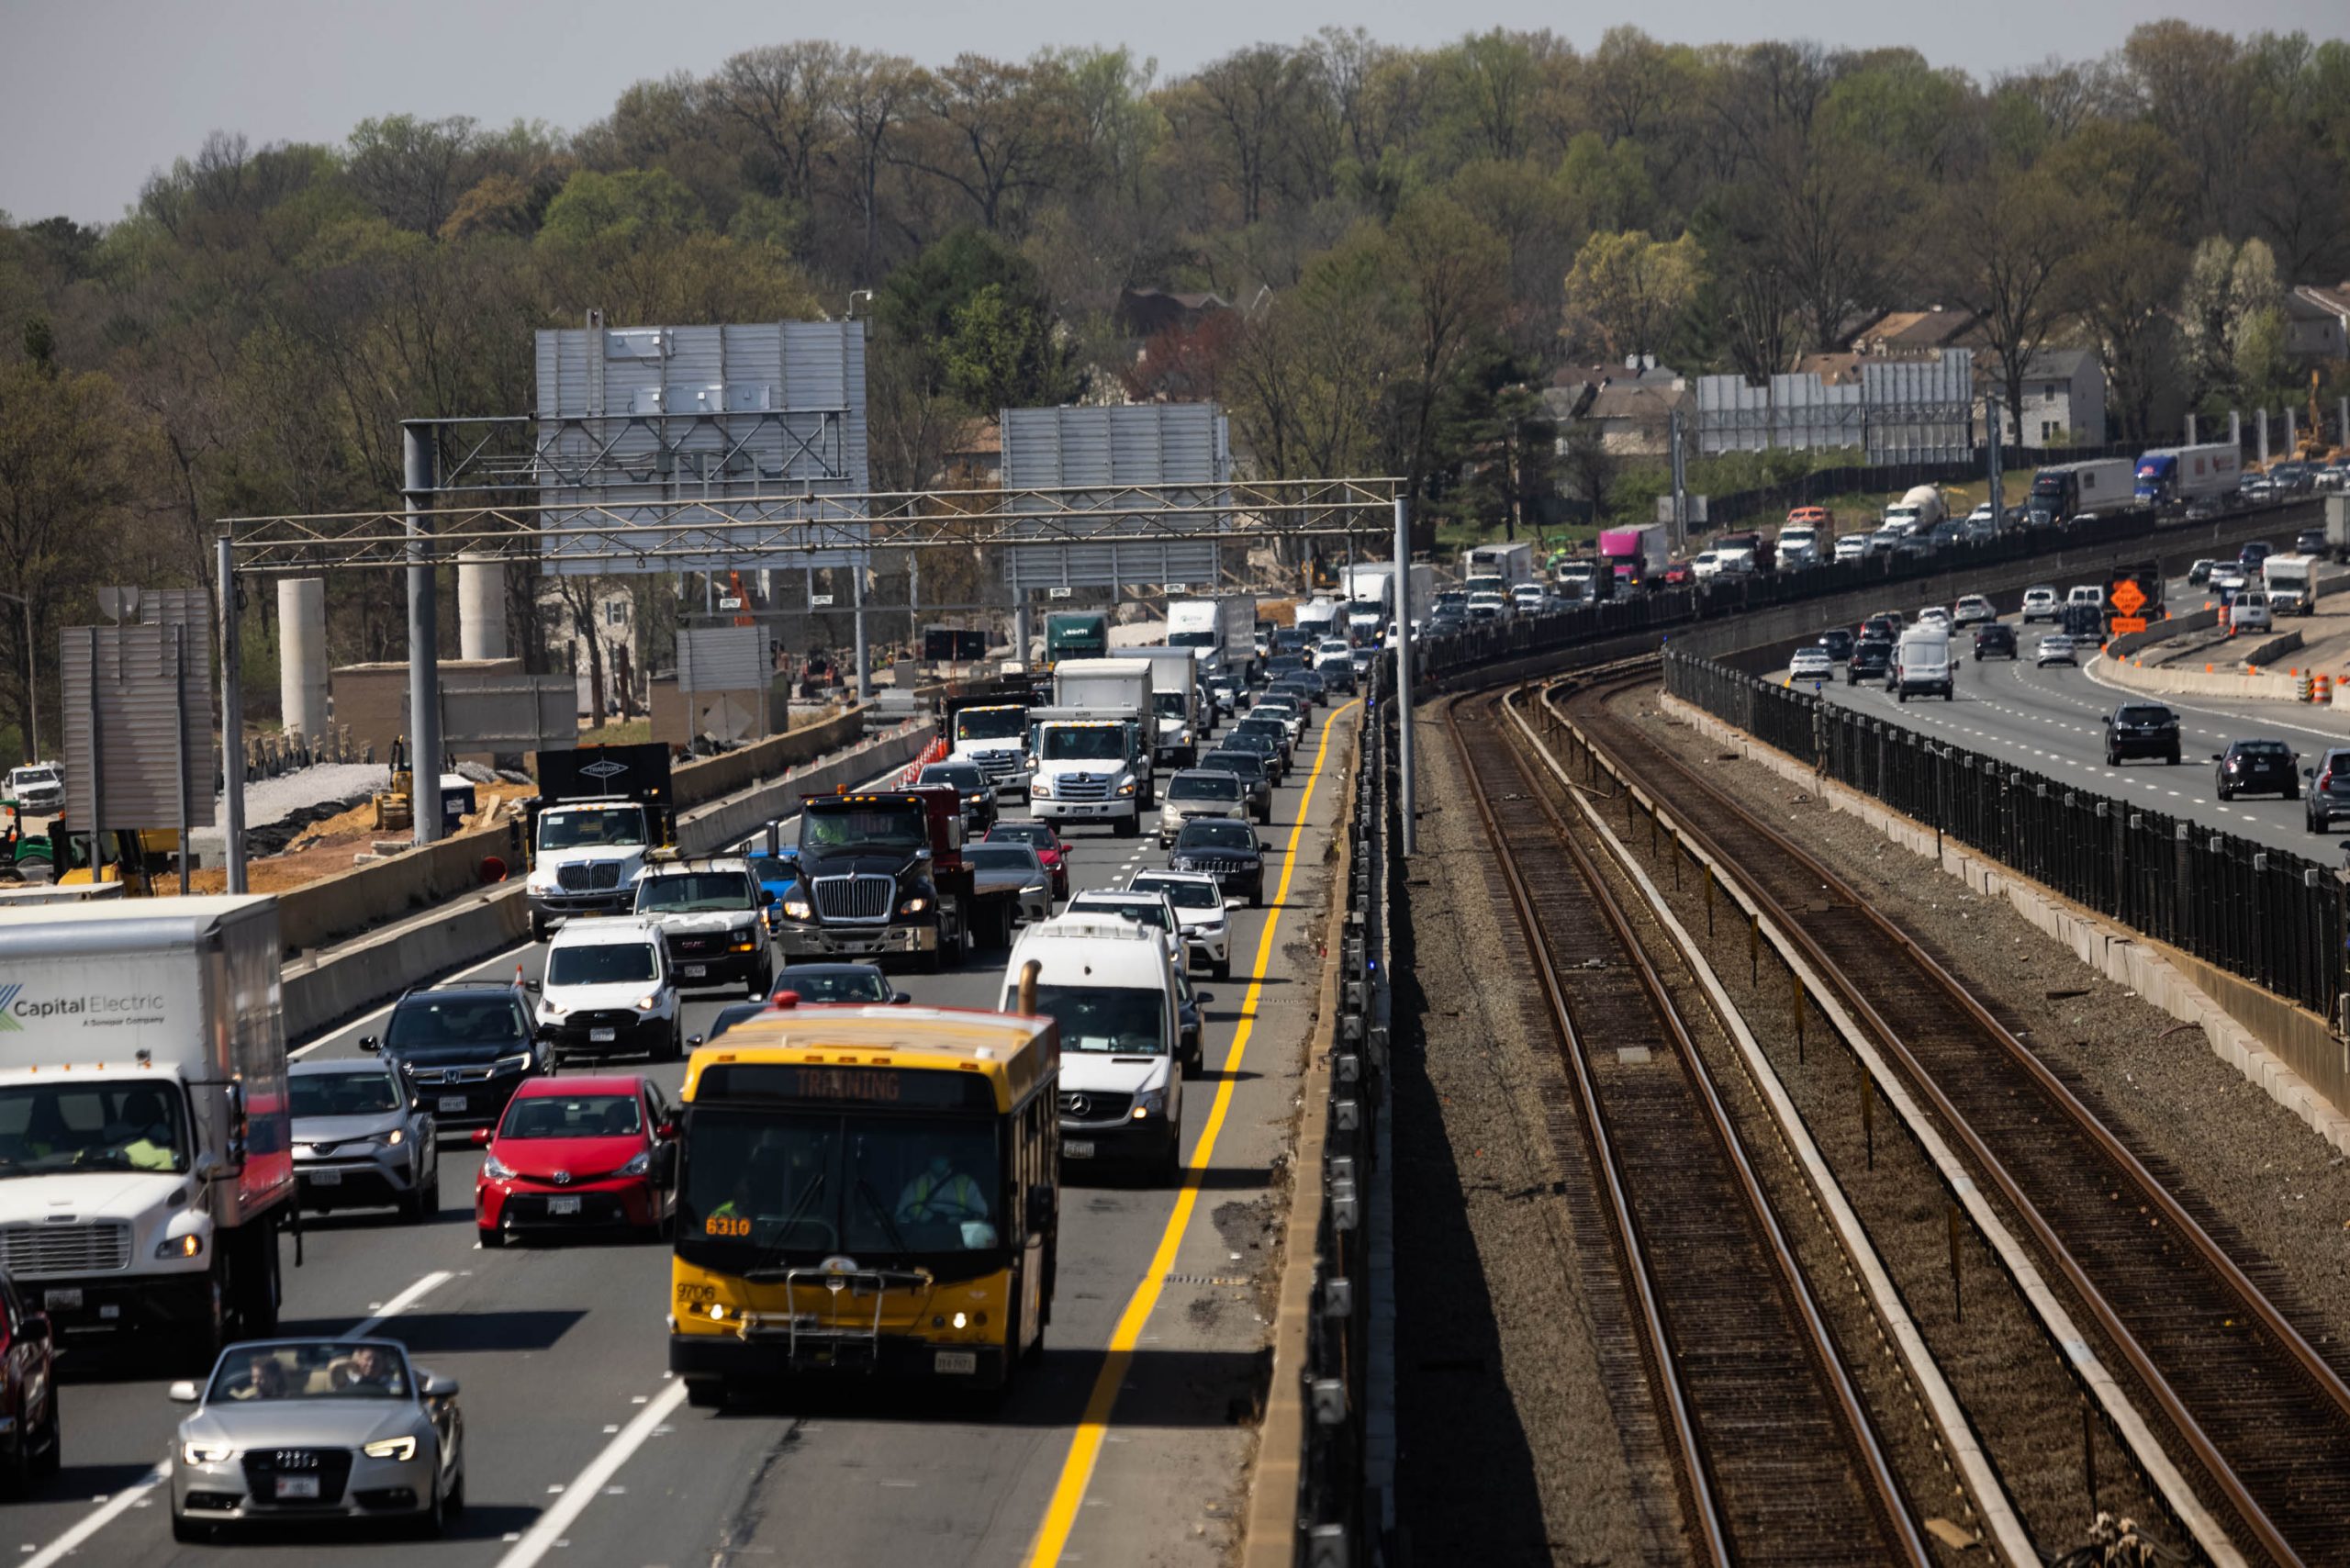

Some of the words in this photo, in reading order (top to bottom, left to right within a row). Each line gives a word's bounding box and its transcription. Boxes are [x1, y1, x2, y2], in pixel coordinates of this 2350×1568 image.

[14, 997, 85, 1018] Capital
[90, 994, 164, 1013] Electric
[126, 1016, 165, 1026] Company
[796, 1070, 900, 1100] TRAINING
[706, 1218, 751, 1236] 6310
[677, 1282, 715, 1301] 9706
